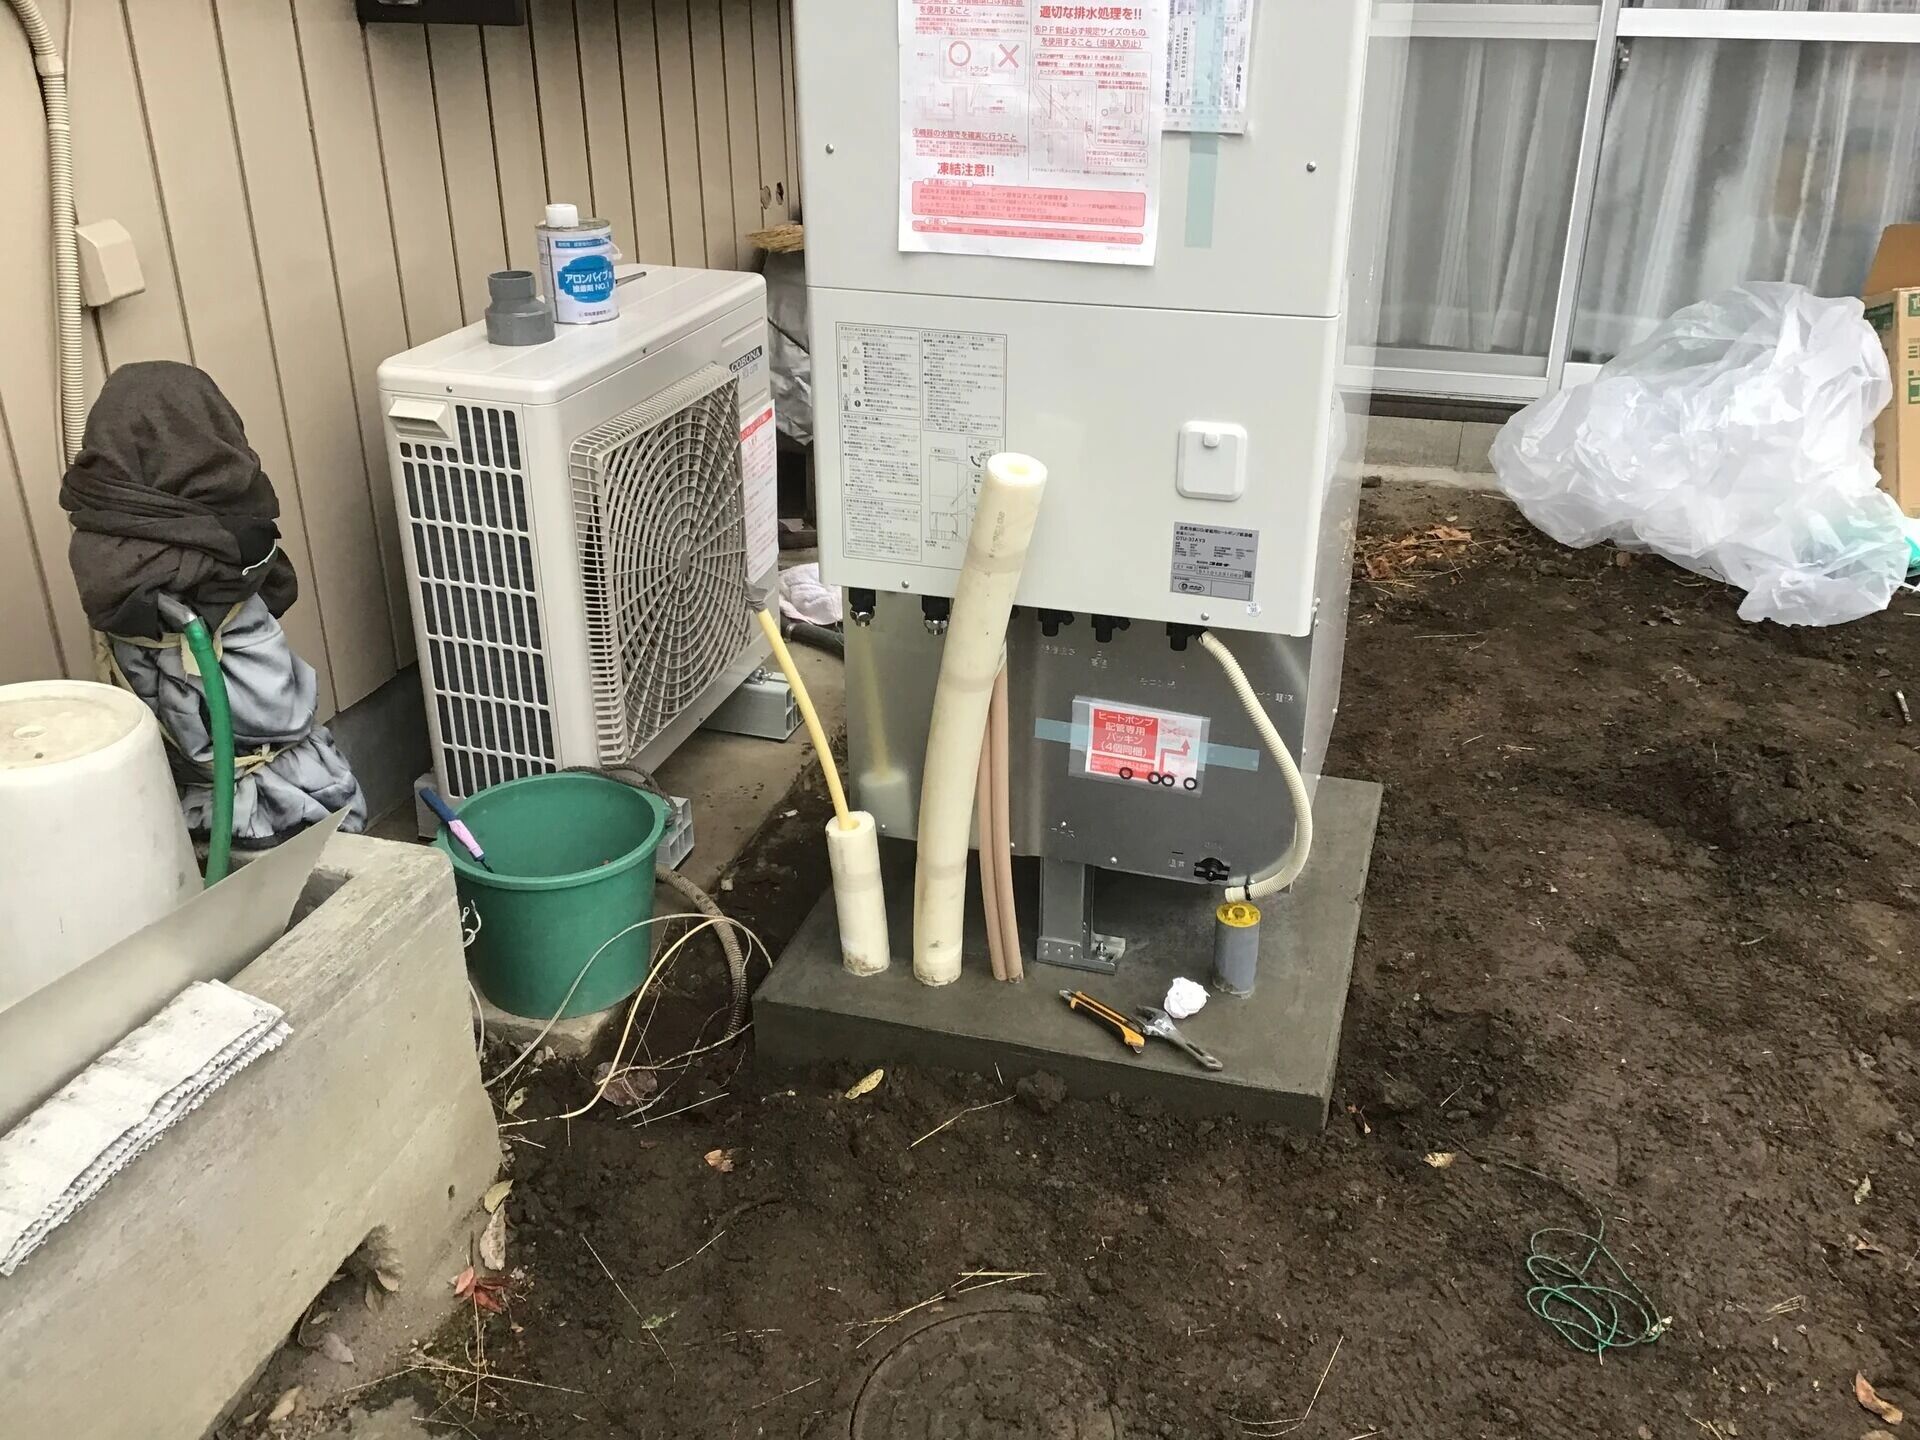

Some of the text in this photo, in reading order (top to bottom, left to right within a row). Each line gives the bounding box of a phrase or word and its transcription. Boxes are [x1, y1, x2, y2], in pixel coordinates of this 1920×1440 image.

[937, 162, 995, 177] 凍結注意!!
[731, 348, 761, 373] CORONA
[1098, 711, 1154, 727] ヒートポンプ
[1105, 722, 1146, 736] 配管専用
[1106, 733, 1144, 745] パッキン
